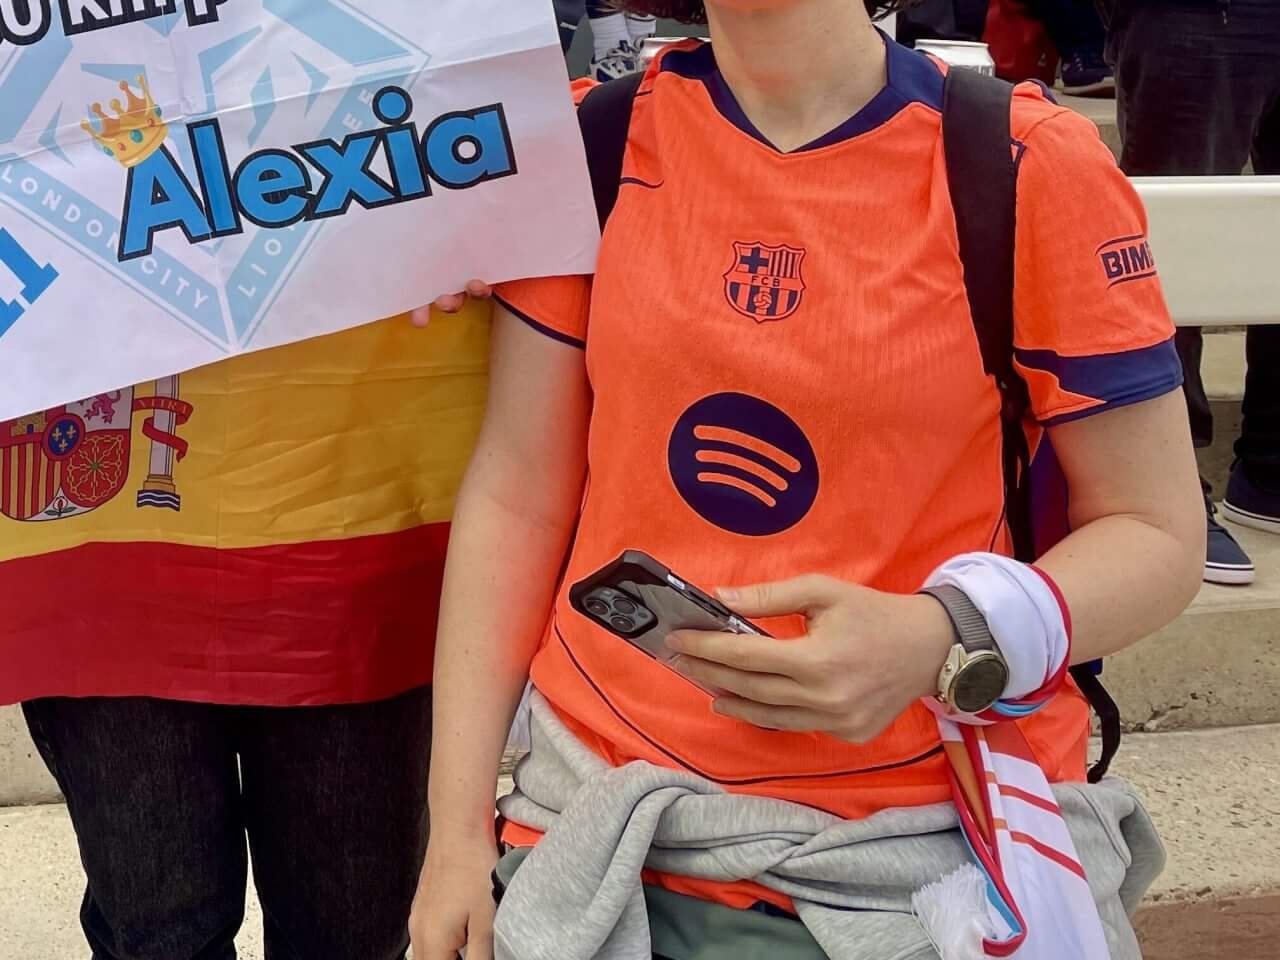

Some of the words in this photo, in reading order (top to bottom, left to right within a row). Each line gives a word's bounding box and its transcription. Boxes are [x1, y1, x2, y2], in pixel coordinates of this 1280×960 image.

[117, 85, 518, 262] Alexia
[141, 257, 209, 309] CITY
[1100, 240, 1155, 280] BIM
